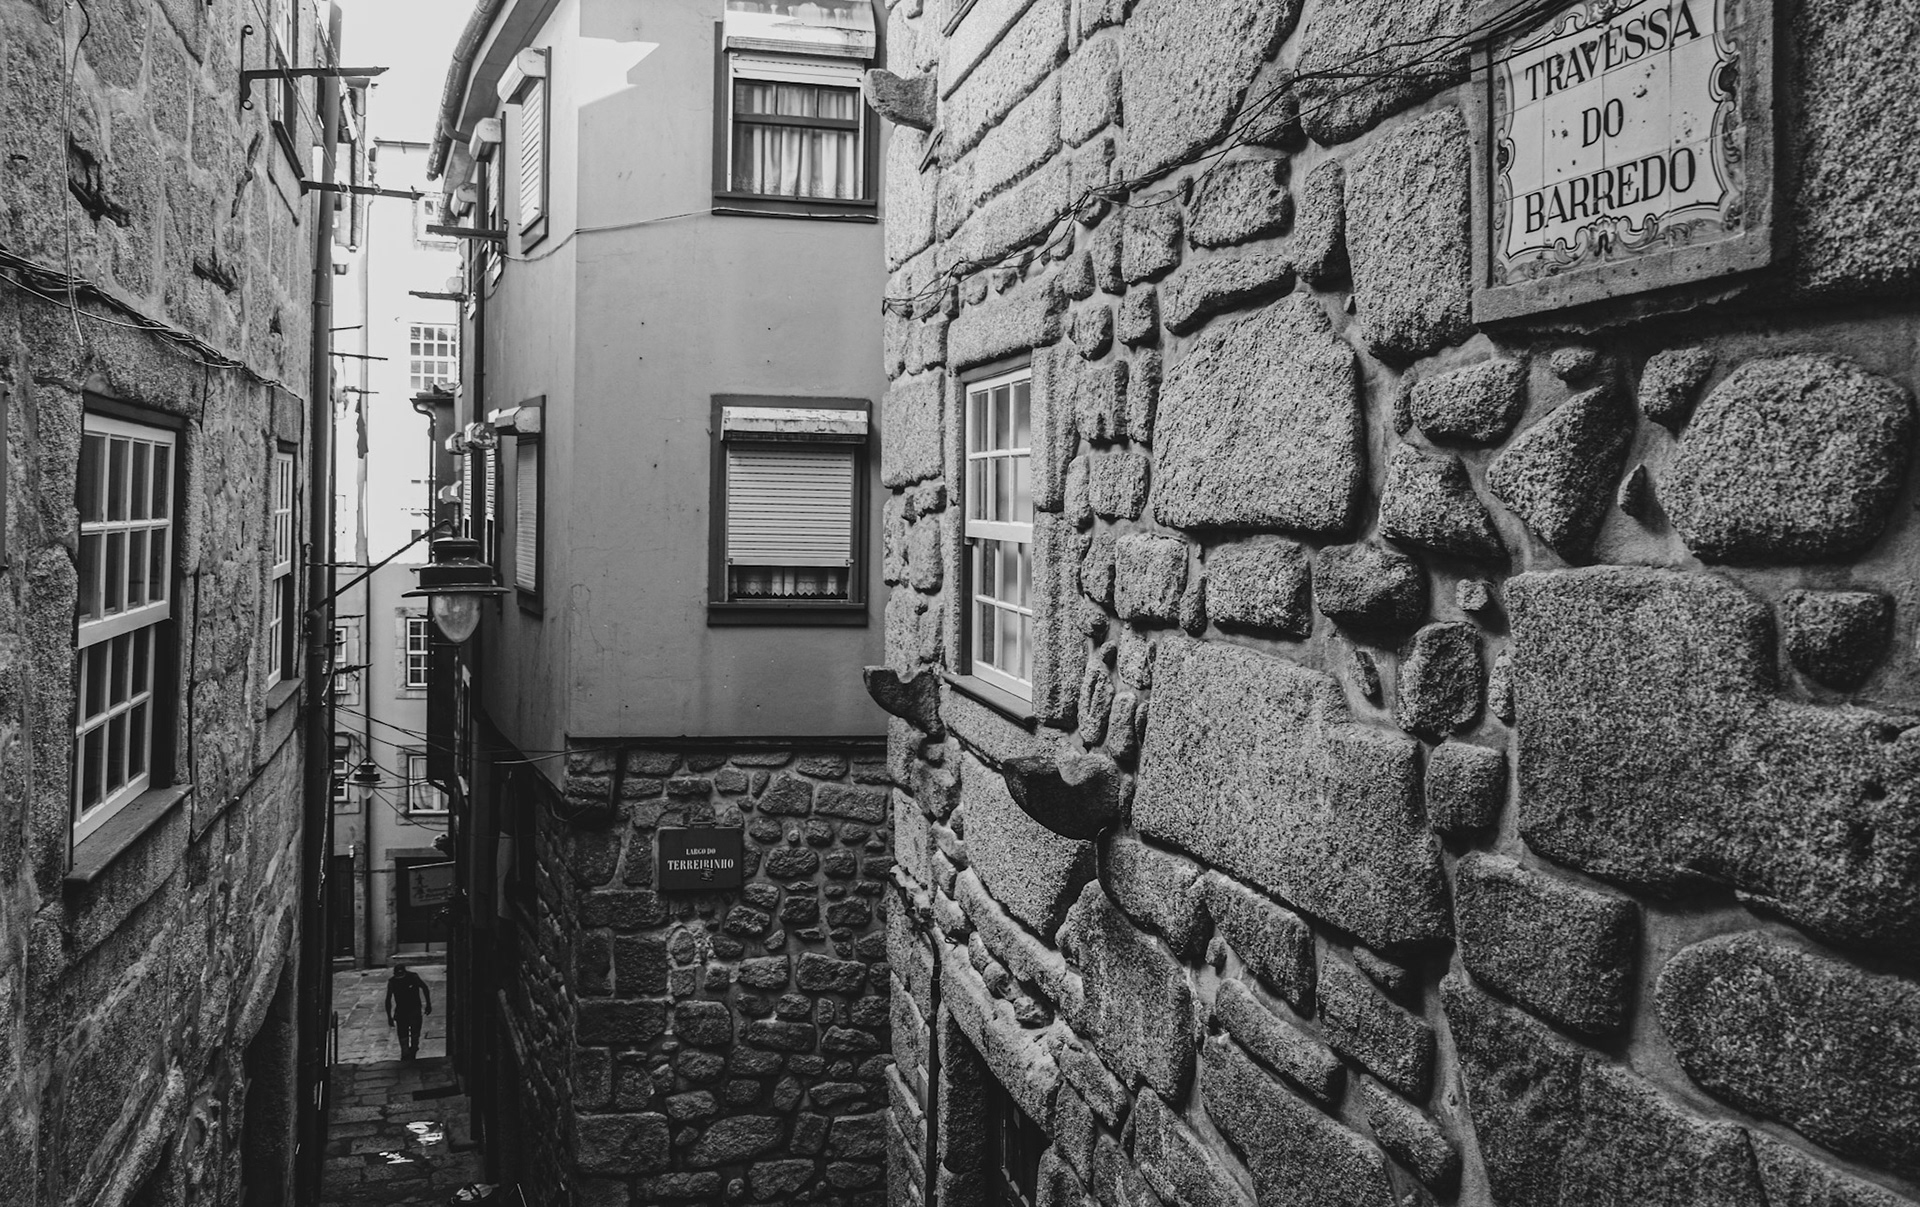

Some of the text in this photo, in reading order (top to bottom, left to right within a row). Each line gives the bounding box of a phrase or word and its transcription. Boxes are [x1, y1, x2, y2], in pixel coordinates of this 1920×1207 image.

[1525, 0, 1700, 101] TRAVESSA
[1581, 98, 1624, 147] DO
[1525, 148, 1696, 233] BARREDO
[667, 859, 734, 870] TERREIRINHO
